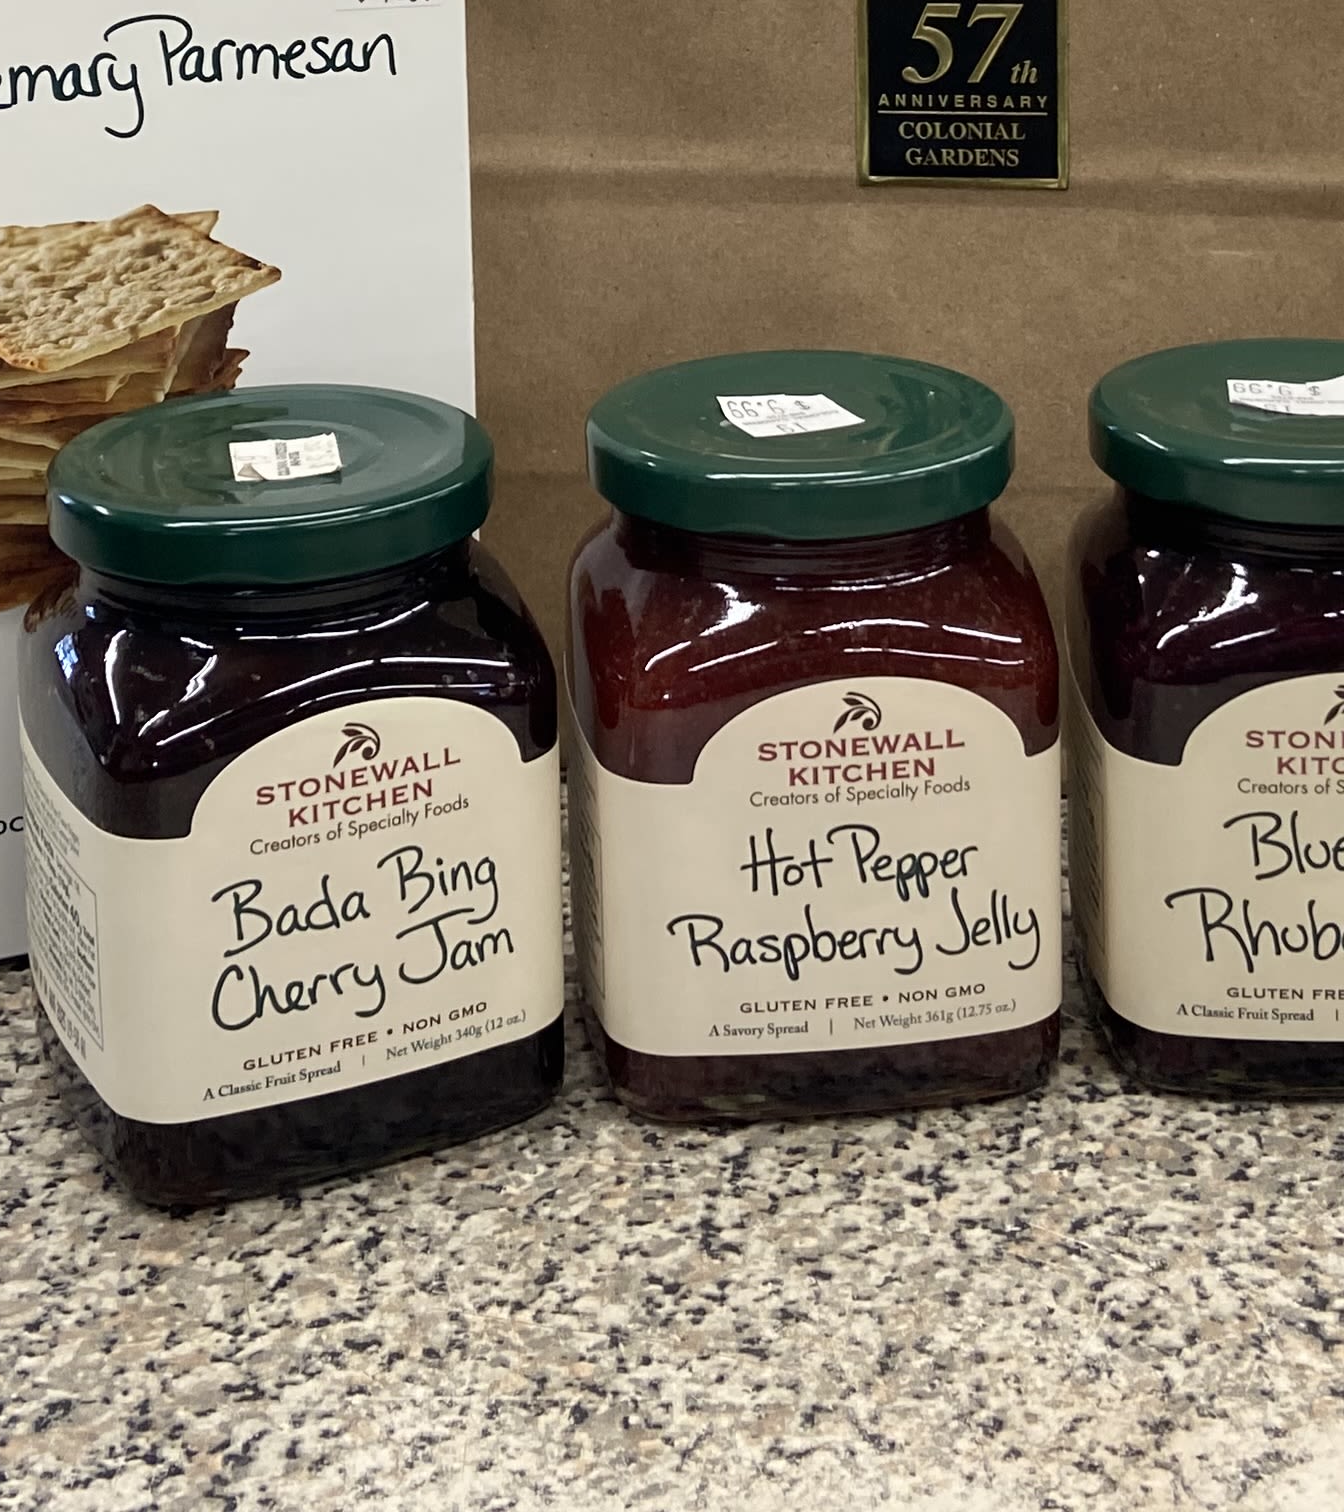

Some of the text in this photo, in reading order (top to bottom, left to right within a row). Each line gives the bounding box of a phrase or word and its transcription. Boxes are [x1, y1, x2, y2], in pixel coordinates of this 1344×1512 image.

[104, 14, 397, 86] Parmesan
[878, 93, 1048, 109] ANNIVERSARY
[898, 121, 1026, 141] COLONIAL
[905, 147, 1020, 168] GARDENS
[757, 729, 965, 762] STONEWALL
[256, 748, 461, 806] STONEWALL
[789, 757, 935, 787] KITCHEN
[1237, 778, 1308, 794] Creators
[1314, 778, 1331, 794] of
[288, 779, 433, 828] KITCHEN
[749, 775, 971, 808] Creators of Specialty Foods
[249, 794, 469, 855] Creators of Specialty Foods
[740, 823, 978, 901] Hot Pepper
[211, 845, 498, 957] Bada Bing
[667, 887, 1041, 981] Raspberry Jelly
[211, 908, 514, 1031] Cherry Jam
[740, 983, 985, 1014] GLUTEN FREE NON GMO
[1226, 987, 1304, 1000] GLUTEN
[708, 1021, 809, 1039] A Savory Spread
[854, 1017, 876, 1031] Net
[879, 1011, 922, 1029] Weight
[924, 1009, 953, 1024] 361g
[956, 1003, 992, 1021] (12.75
[1176, 1004, 1314, 1025] A Classic Fruit Spread
[243, 1002, 488, 1071] GLUTEN FREE NON GMO
[386, 1046, 408, 1061] Net
[410, 1033, 452, 1054] Weight
[455, 1025, 483, 1044] 340g
[202, 1061, 341, 1101] A Classic Fruit Spread
